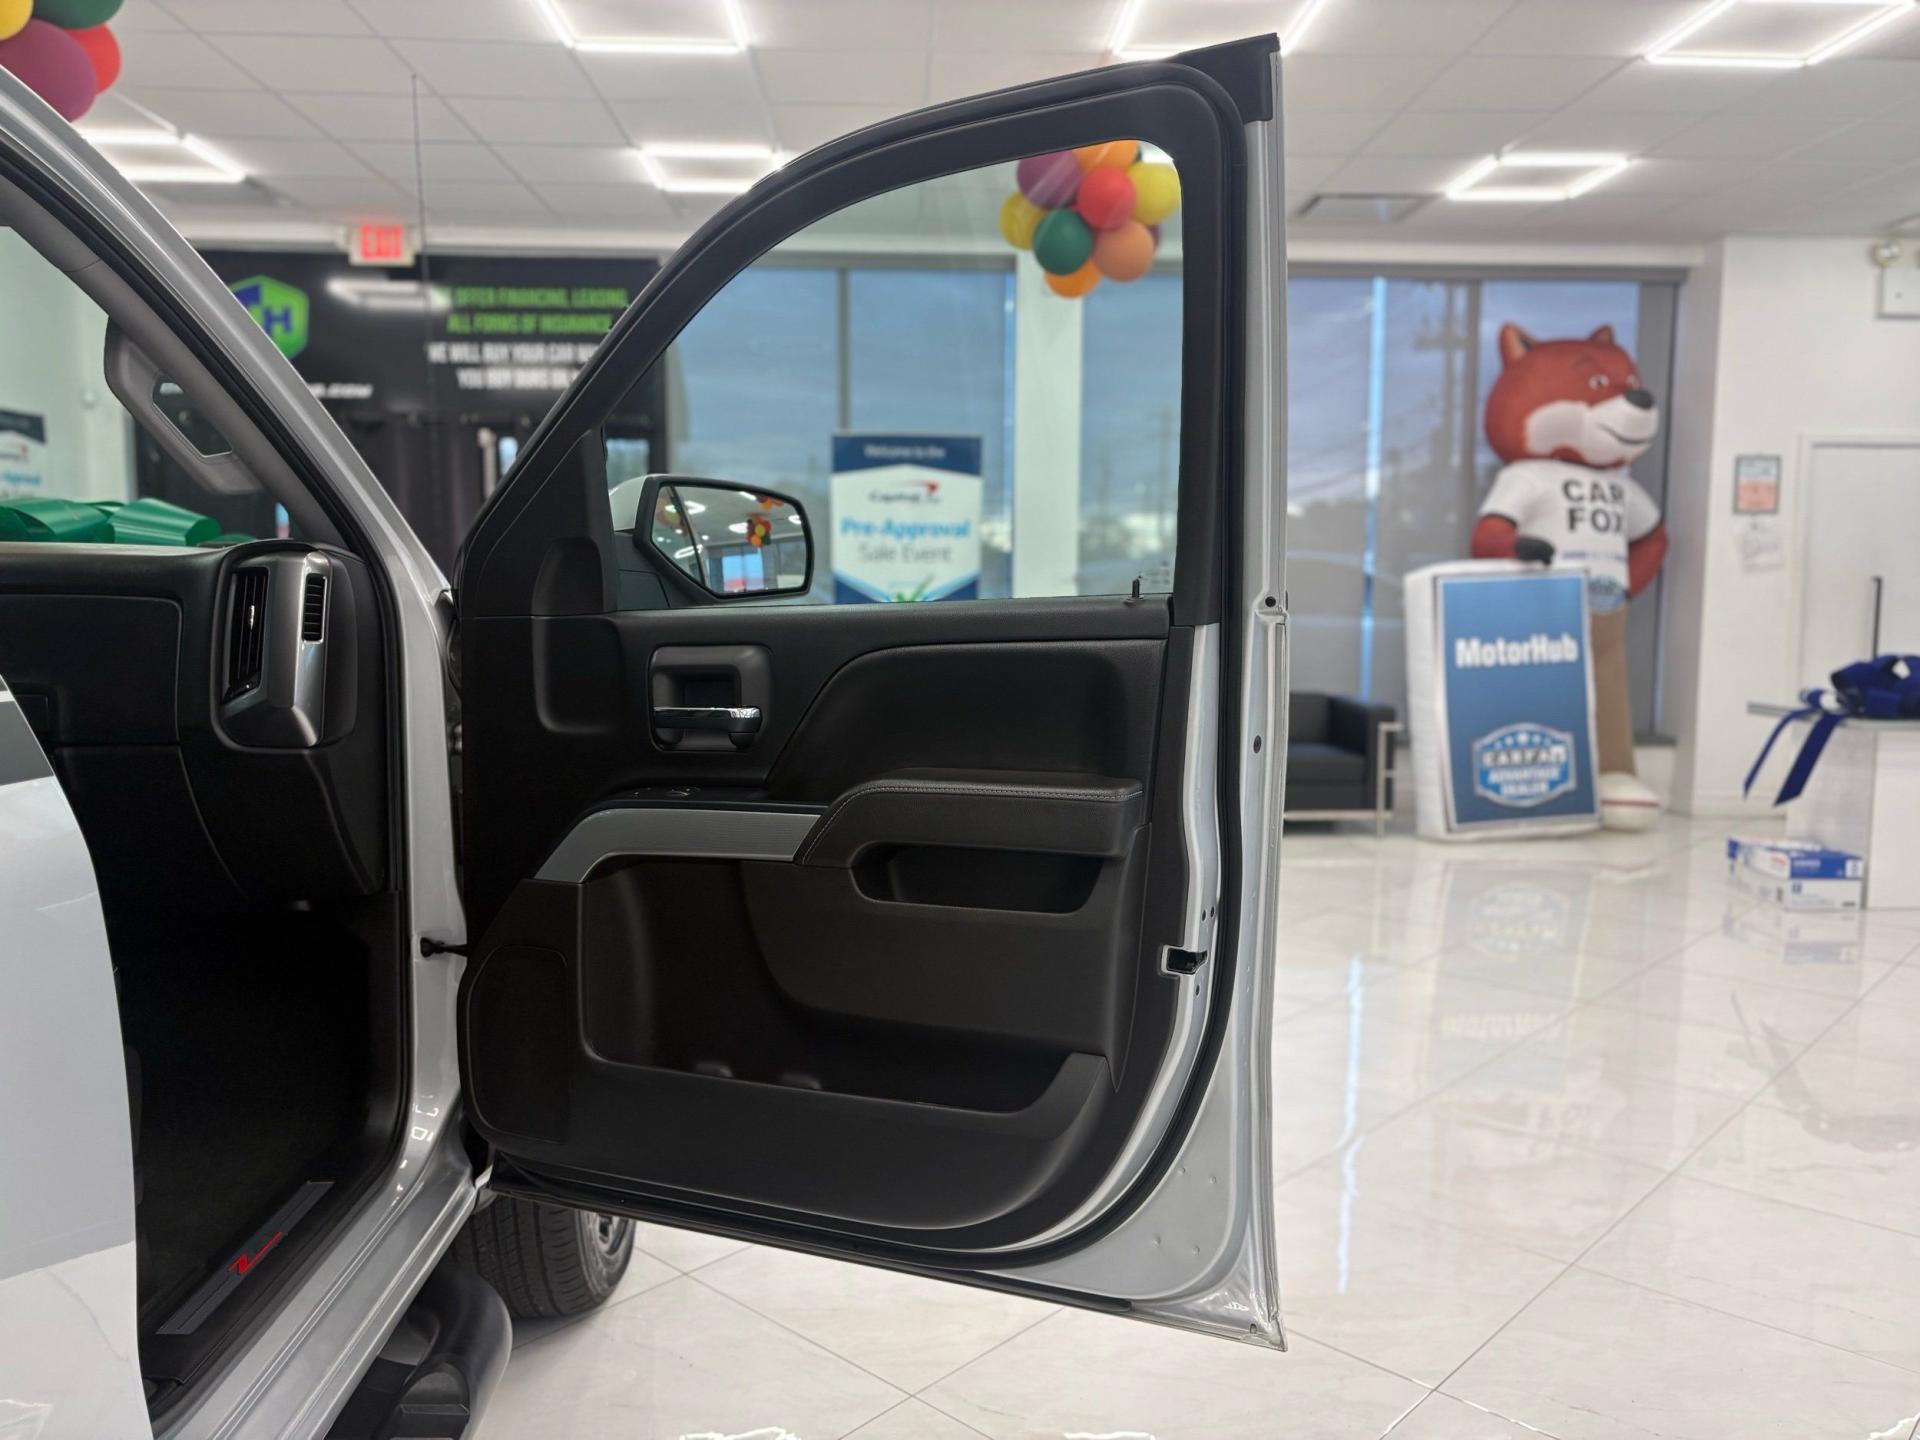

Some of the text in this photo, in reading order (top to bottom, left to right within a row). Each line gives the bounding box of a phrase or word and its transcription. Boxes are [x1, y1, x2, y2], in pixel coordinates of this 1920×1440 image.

[359, 224, 403, 262] EXIT
[446, 313, 471, 334] ALL
[473, 313, 518, 334] FORMS
[427, 342, 447, 363] WE
[449, 342, 480, 363] WILL
[481, 342, 510, 363] BUY
[511, 342, 545, 363] YOUR
[548, 342, 574, 364] CAR
[456, 367, 483, 389] YOU
[840, 515, 972, 541] Pre-Approval
[857, 542, 953, 563] Sale Event
[1455, 632, 1580, 669] MotorHub
